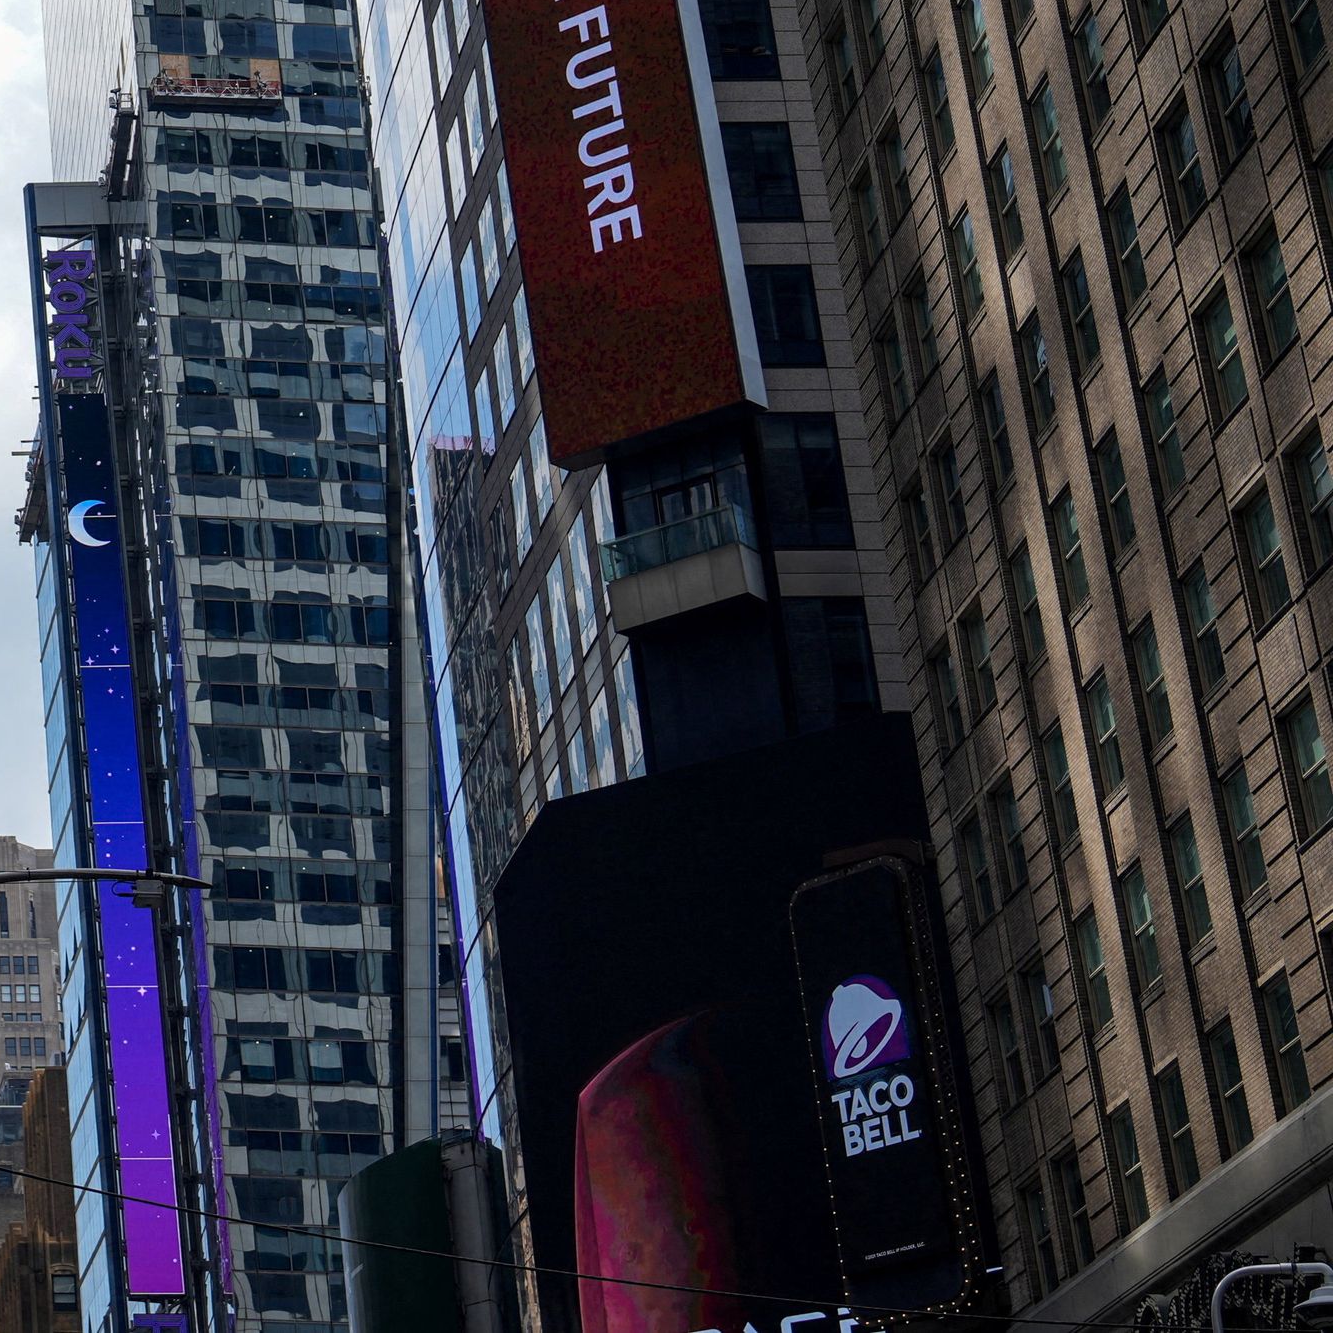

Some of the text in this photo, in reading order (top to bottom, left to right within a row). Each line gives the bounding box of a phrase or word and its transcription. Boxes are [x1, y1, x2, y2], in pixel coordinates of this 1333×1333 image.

[558, 4, 643, 254] FUTURE
[831, 1074, 914, 1124] TACO
[842, 1109, 921, 1157] BELL
